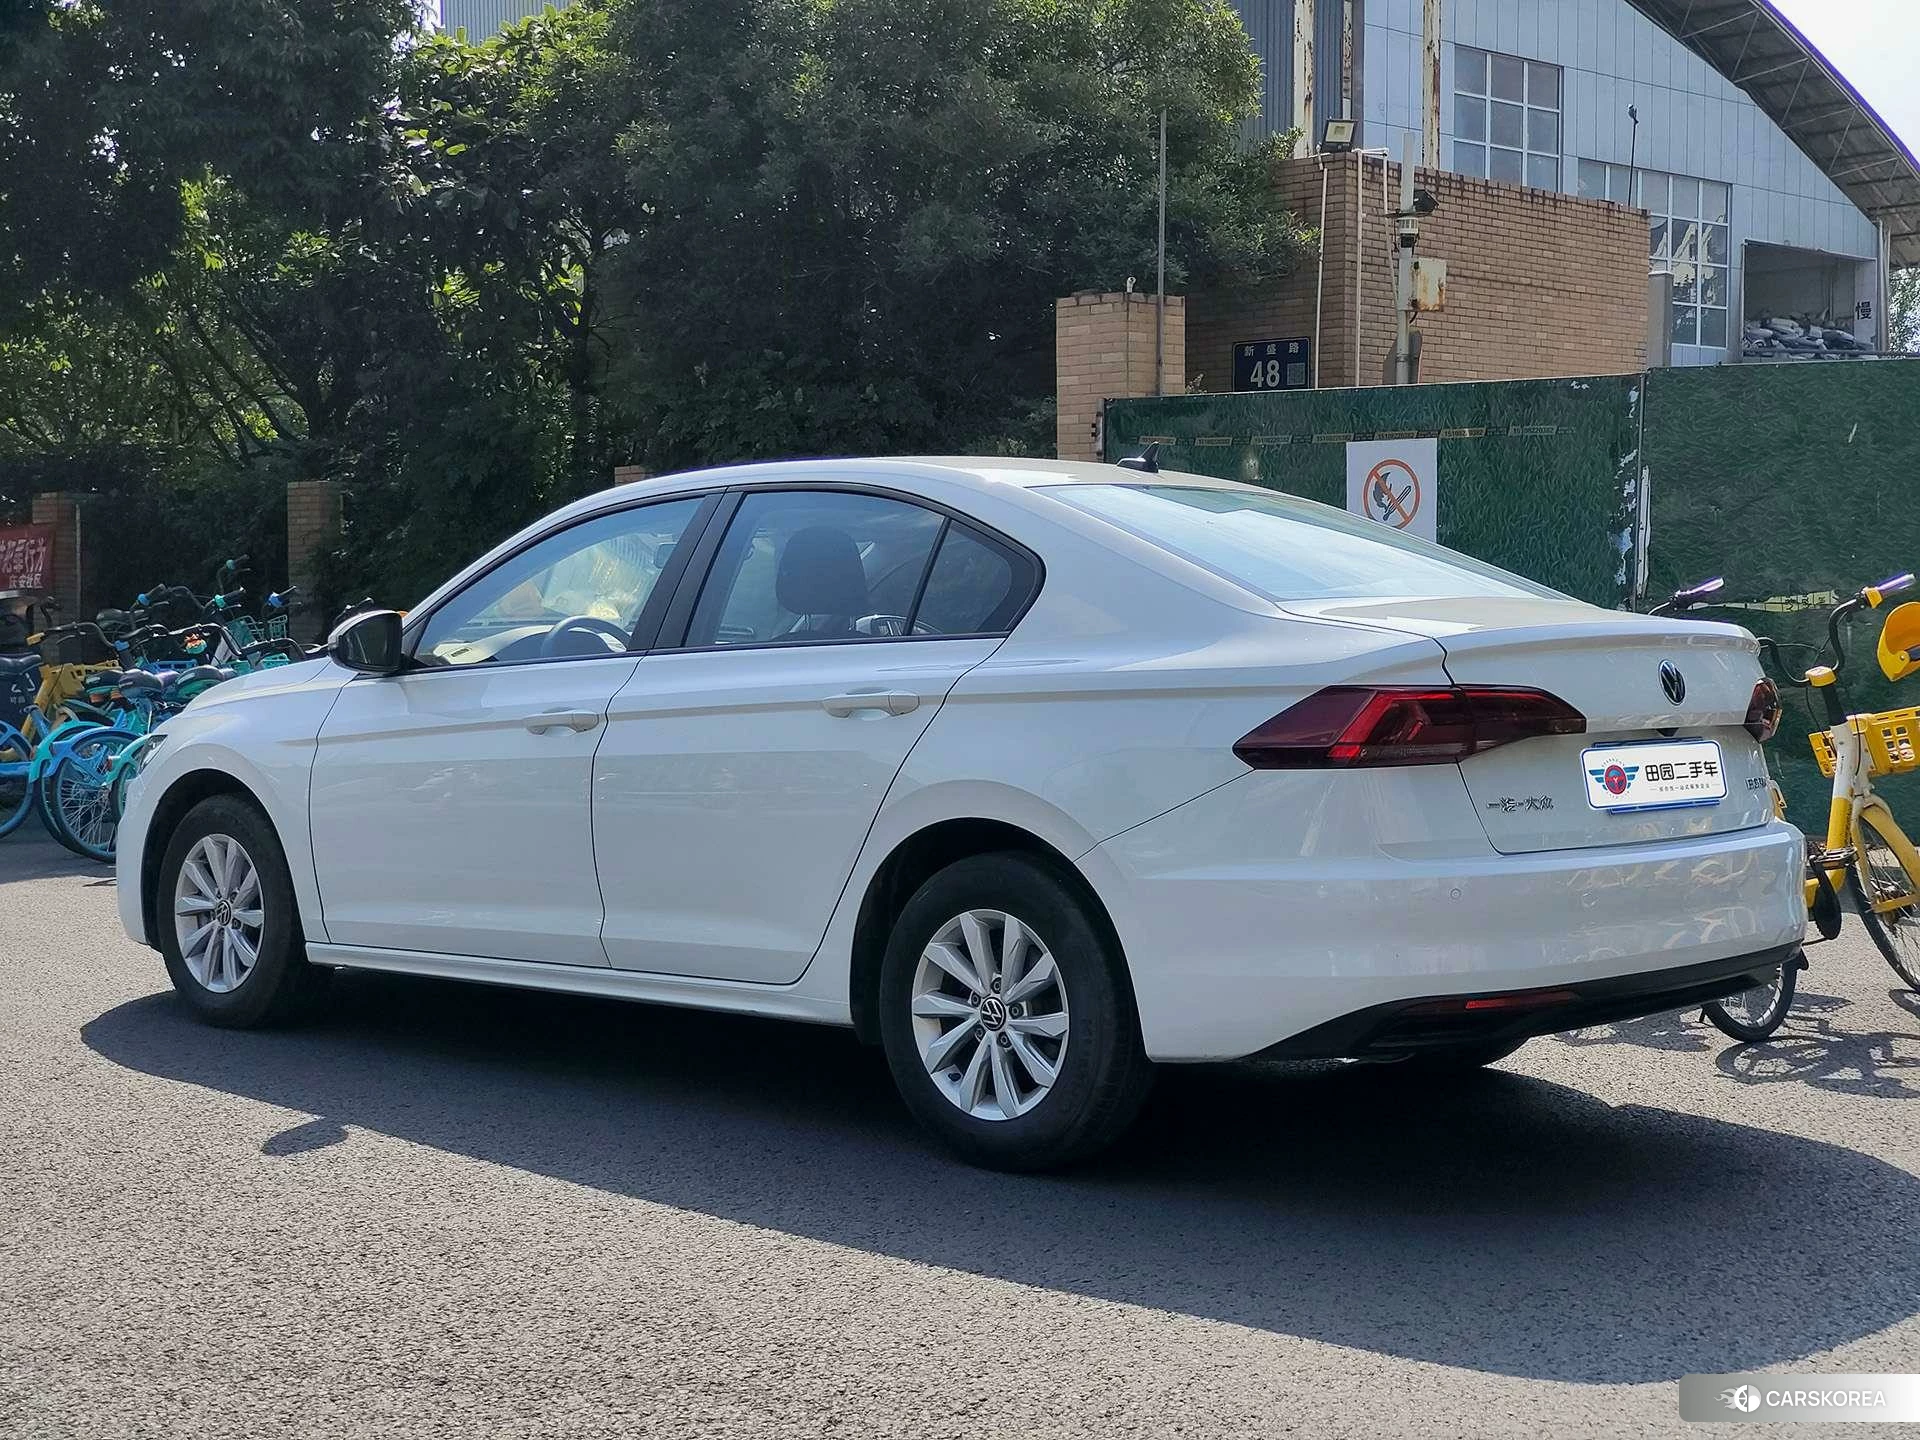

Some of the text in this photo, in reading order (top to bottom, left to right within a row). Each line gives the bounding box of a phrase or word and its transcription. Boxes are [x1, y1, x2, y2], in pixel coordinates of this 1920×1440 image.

[1250, 360, 1280, 388] 48
[1645, 761, 1718, 781] 田园二手车
